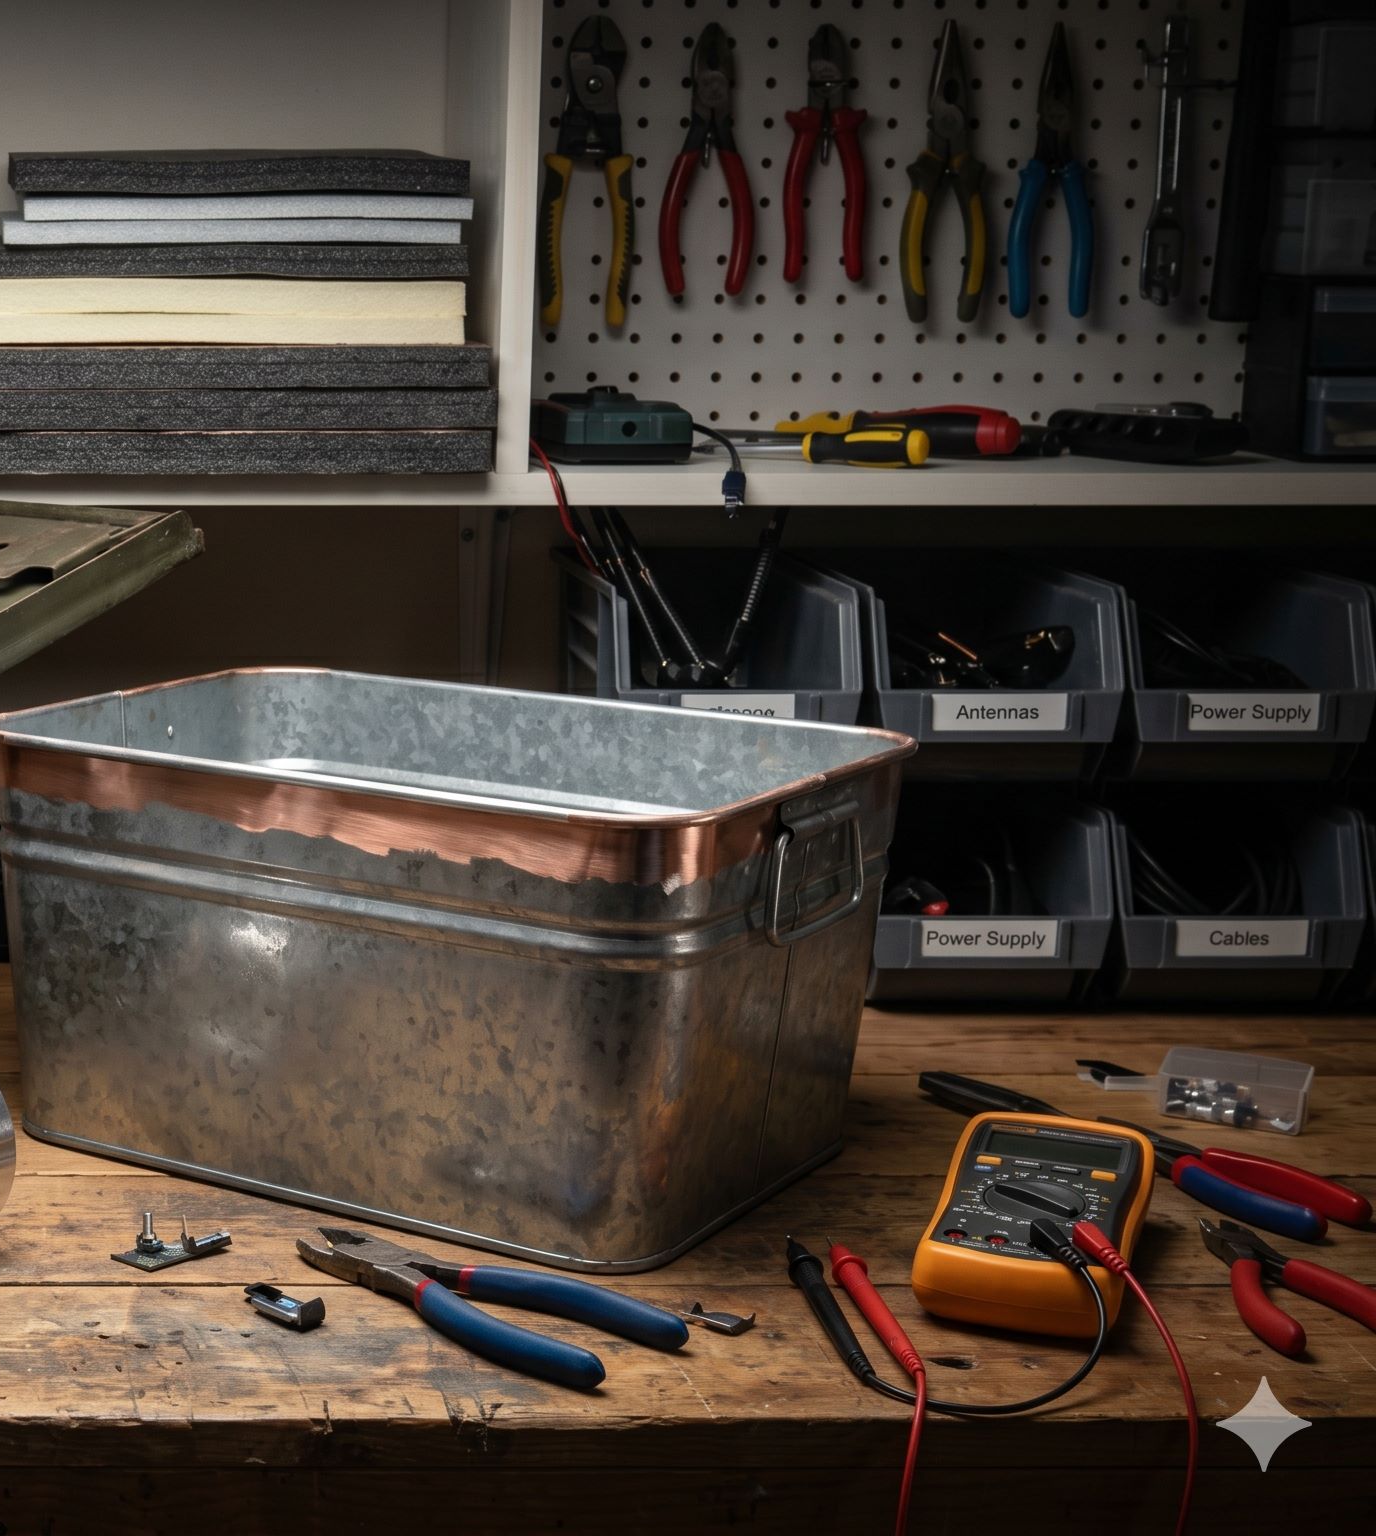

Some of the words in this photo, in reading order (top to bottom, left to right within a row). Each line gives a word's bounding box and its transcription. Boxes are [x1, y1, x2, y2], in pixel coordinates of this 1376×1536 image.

[956, 704, 1040, 720] Antennas
[1190, 704, 1246, 720] Power
[1251, 704, 1312, 724] Supply
[926, 930, 982, 946] Power
[986, 930, 1047, 950] Supply
[1209, 930, 1270, 946] Cables
